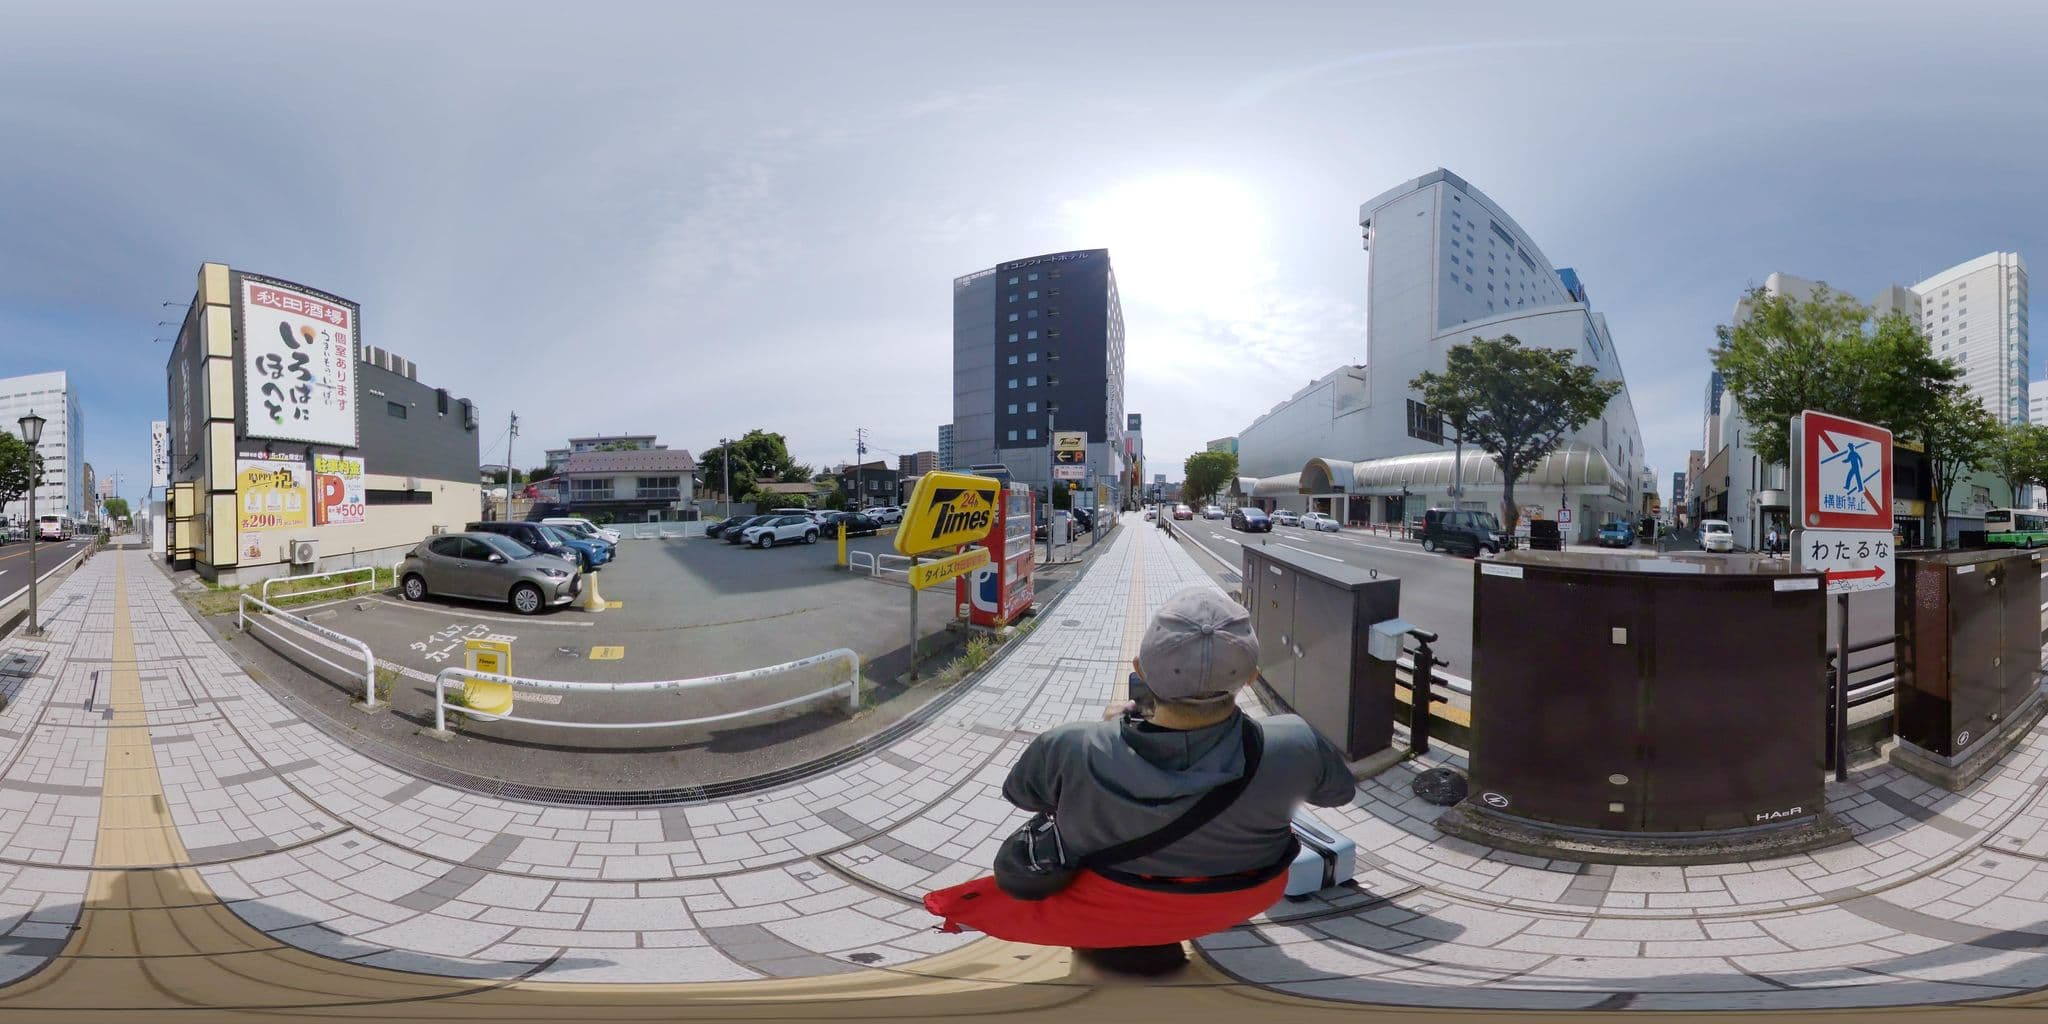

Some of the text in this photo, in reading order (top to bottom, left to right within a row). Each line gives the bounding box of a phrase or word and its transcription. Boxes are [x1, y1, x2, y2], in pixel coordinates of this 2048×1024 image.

[257, 291, 344, 325] 秋田酒場
[256, 353, 285, 420] ほへと
[279, 321, 316, 421] いろはに
[335, 332, 347, 411] 個室あります
[931, 501, 990, 539] Times
[1824, 493, 1867, 512] 横断禁止
[1811, 540, 1889, 560] わたるな
